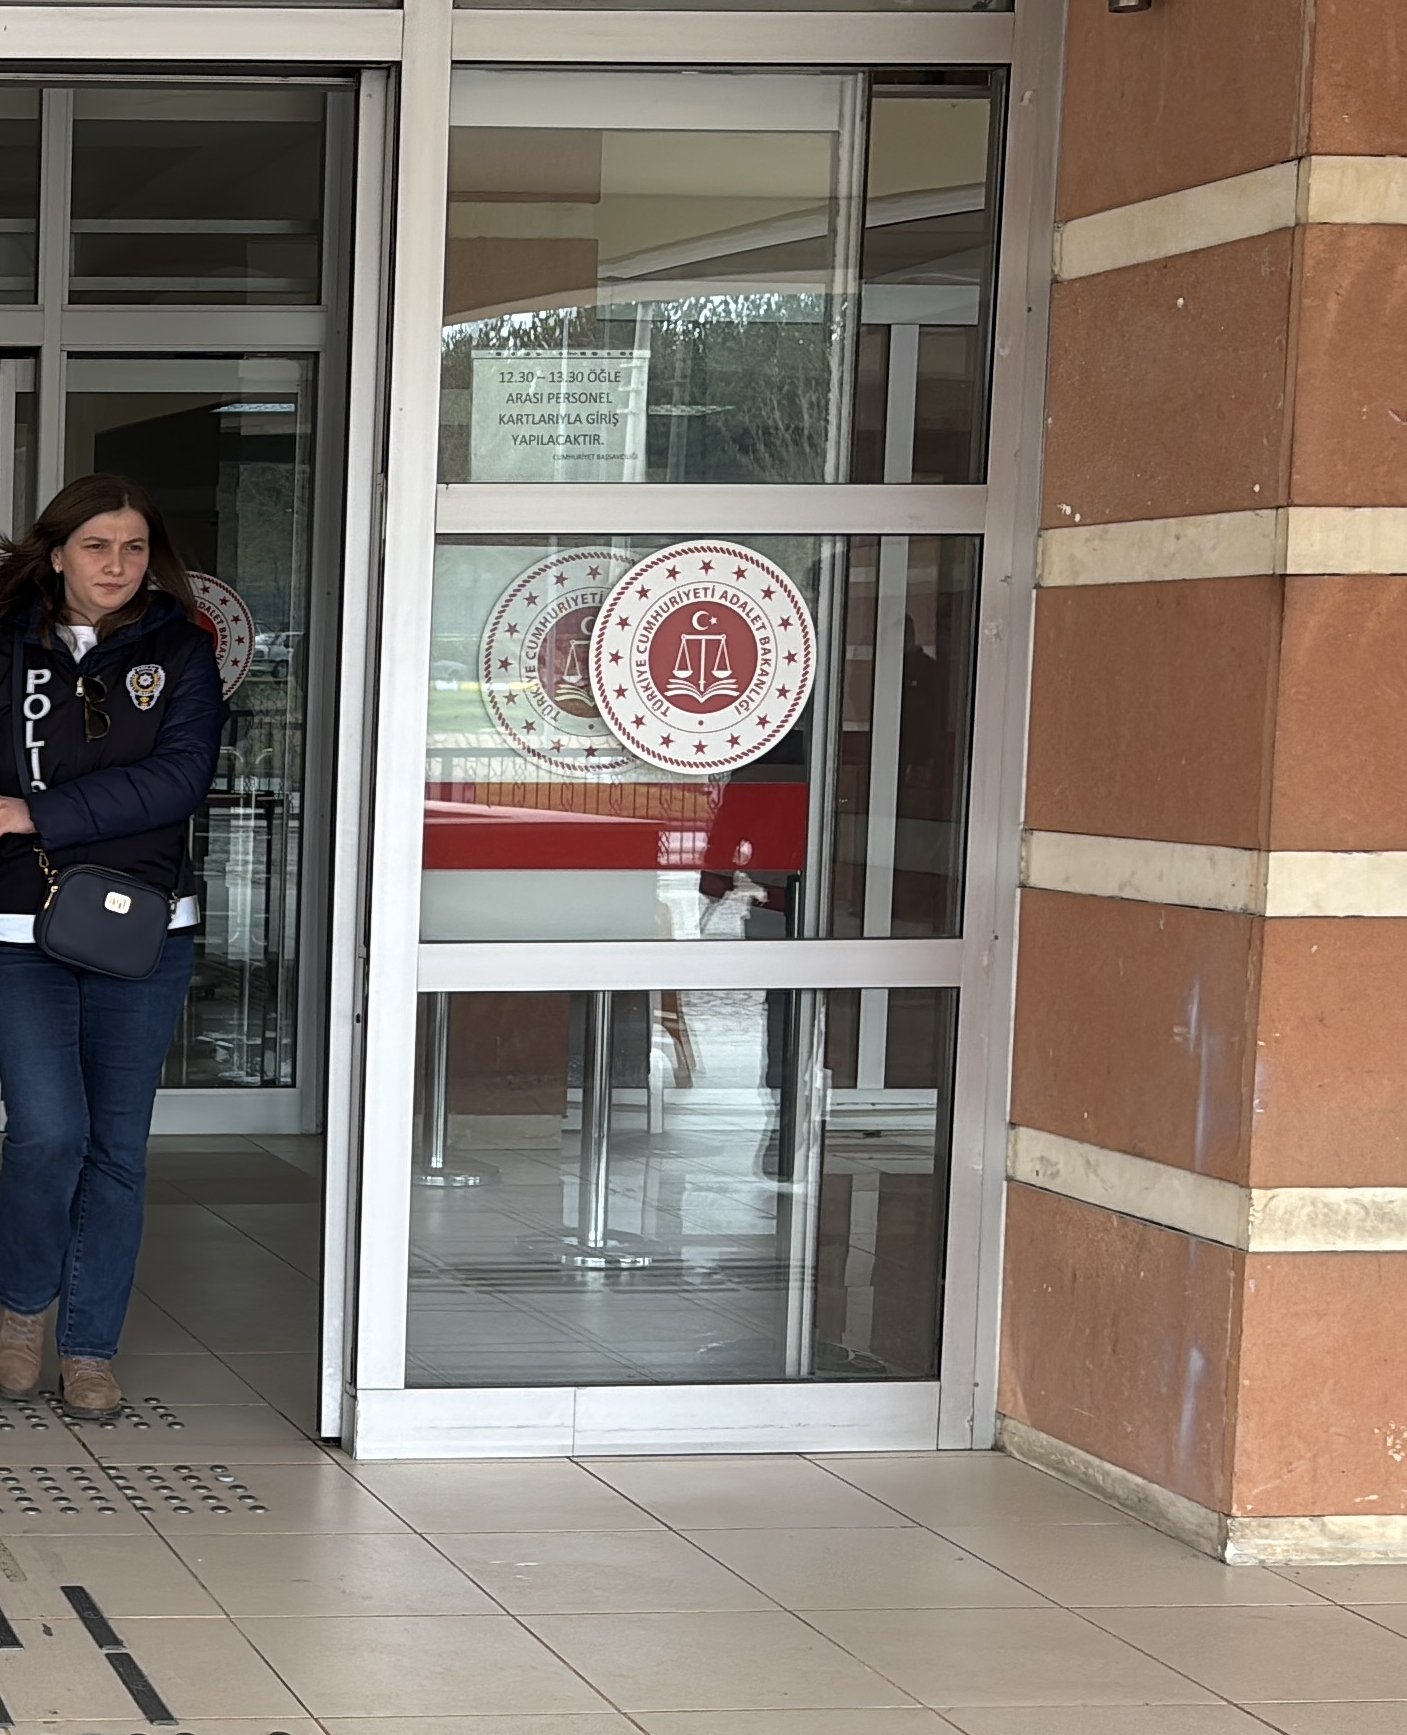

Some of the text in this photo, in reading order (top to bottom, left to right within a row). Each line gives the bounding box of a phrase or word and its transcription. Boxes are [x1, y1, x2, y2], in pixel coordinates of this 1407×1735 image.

[499, 371, 534, 383] 12.30
[549, 371, 584, 383] 13.30
[588, 369, 621, 383] ÖĞLE
[506, 393, 612, 404] ARASI PERSONEL
[499, 411, 619, 427] KARTLARIYLA GİRİŞ
[512, 434, 604, 445] YAPILACAKTIR.
[634, 585, 772, 718] TÜRKİYE CUMHURİYETİ ADALET BAKANLIĞI
